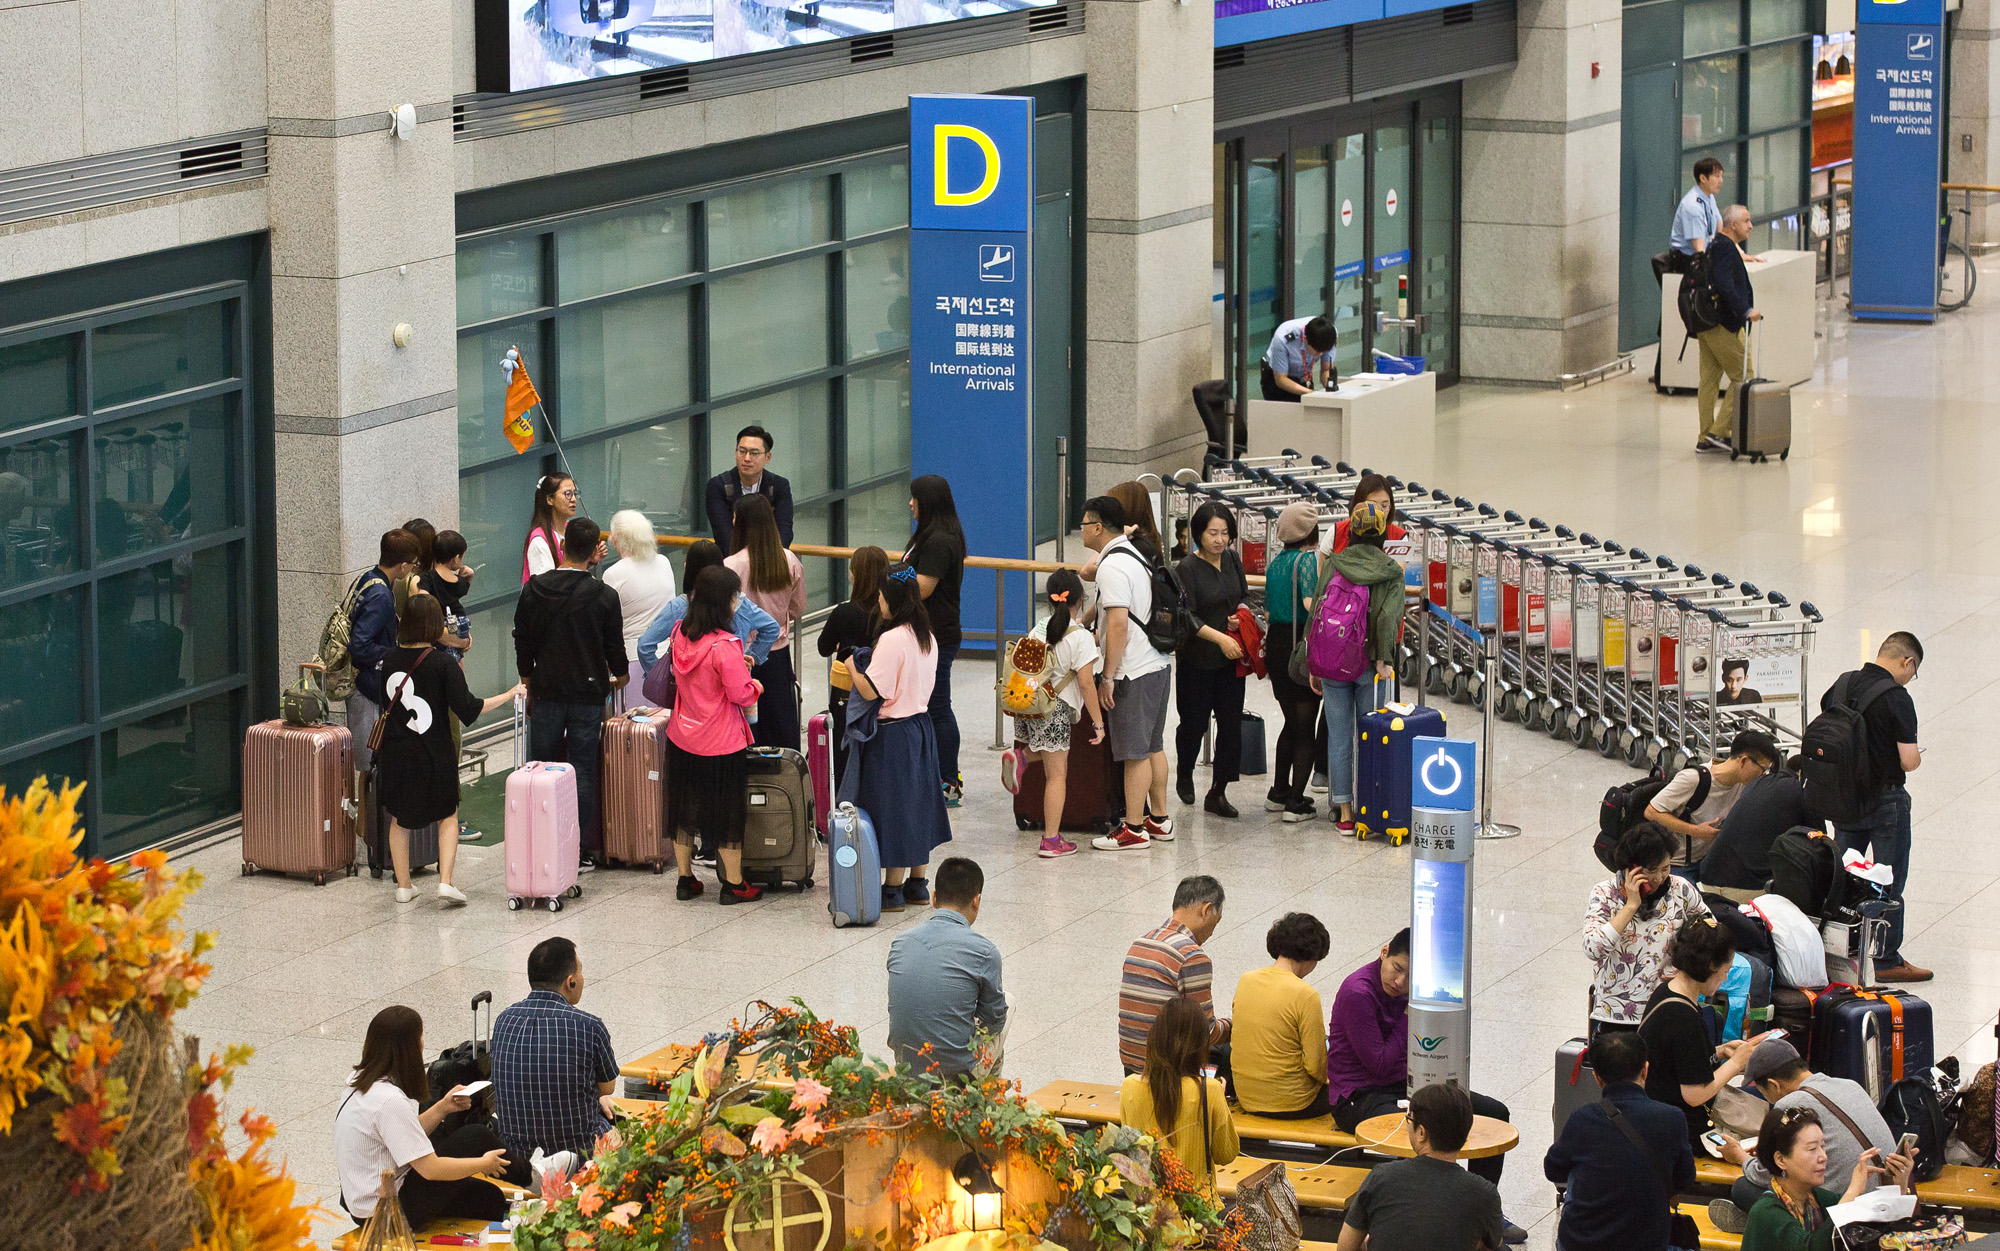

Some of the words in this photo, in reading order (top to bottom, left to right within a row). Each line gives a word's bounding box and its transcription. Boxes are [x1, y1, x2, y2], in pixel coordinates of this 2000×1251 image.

[1870, 113, 1932, 125] International
[1896, 125, 1932, 135] Arrivals
[934, 124, 1001, 206] D
[935, 296, 1015, 316] 국제선도착
[955, 323, 1015, 339] 国際線到着
[955, 341, 1015, 357] 国际线到达
[930, 362, 1015, 377] International
[965, 377, 1015, 392] Arrivals
[1414, 822, 1456, 836] CHARGE
[1840, 906, 1856, 916] FREE
